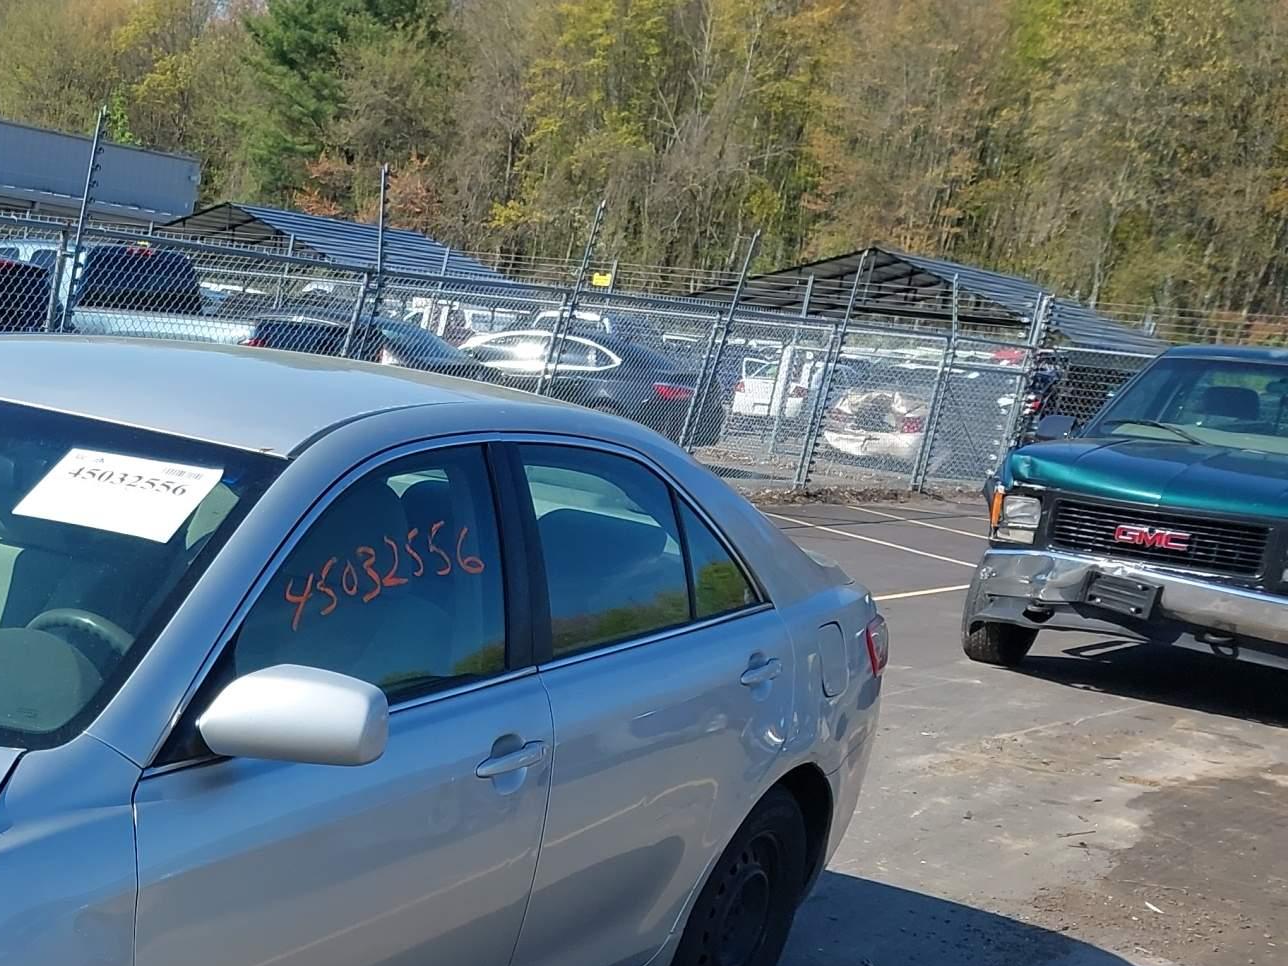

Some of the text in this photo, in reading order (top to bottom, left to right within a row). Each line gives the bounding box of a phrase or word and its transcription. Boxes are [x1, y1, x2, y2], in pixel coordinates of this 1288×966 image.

[68, 466, 189, 496] 45032556
[1114, 525, 1191, 551] GMC
[285, 519, 485, 631] 45032556
